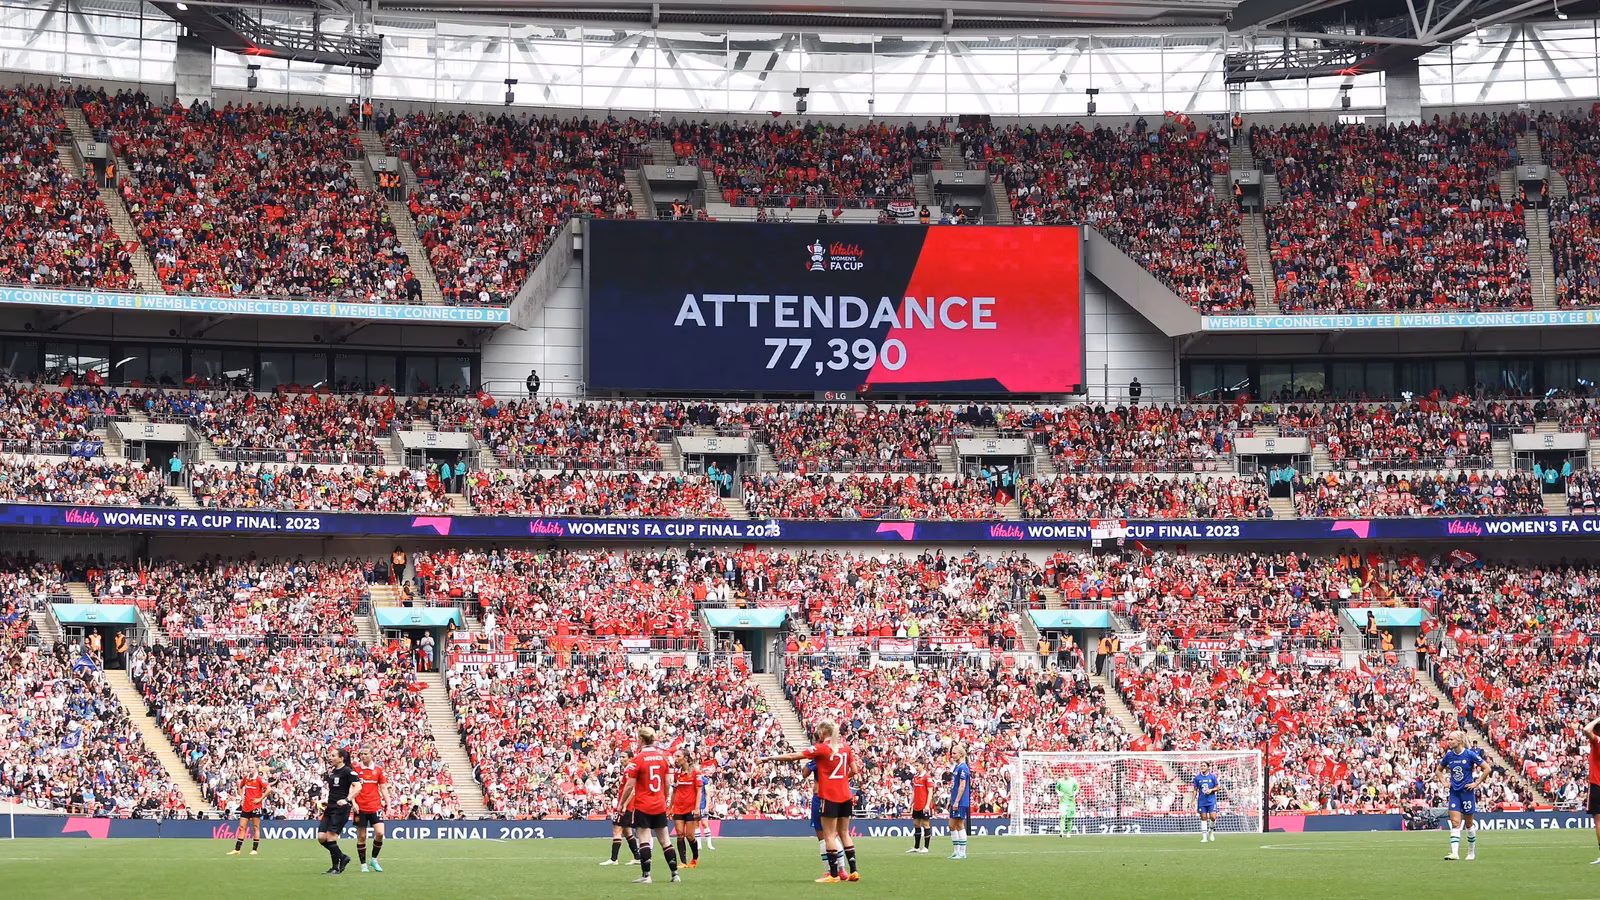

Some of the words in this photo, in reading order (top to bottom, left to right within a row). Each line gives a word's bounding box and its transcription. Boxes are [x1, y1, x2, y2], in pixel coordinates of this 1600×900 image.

[829, 241, 864, 260] Vitality
[830, 262, 842, 270] FA
[843, 262, 864, 271] CUP
[14, 291, 93, 305] CONNECTED
[97, 293, 114, 306] BY
[118, 294, 132, 306] EE
[144, 297, 207, 310] WEMBLEY
[210, 299, 288, 313] CONNECTED
[293, 302, 308, 314] BY
[312, 304, 327, 315] EE
[338, 306, 402, 318] WEMBLEY
[404, 307, 483, 320] CONNECTED
[487, 310, 504, 320] BY
[674, 293, 997, 329] ATTENDANCE
[1403, 315, 1465, 325] WEMBLEY
[1467, 314, 1545, 325] CONNECTED
[1550, 313, 1567, 323] BY
[1569, 313, 1584, 323] EE
[1209, 317, 1273, 328] WEMBLEY
[1275, 316, 1353, 327] CONNECTED
[1357, 316, 1374, 326] BY
[1377, 316, 1391, 326] EE
[764, 338, 907, 376] 77,390
[835, 392, 847, 400] LG
[64, 508, 99, 527] Vitality
[102, 512, 175, 527] WOMEN'S
[180, 515, 198, 527] FA
[202, 515, 232, 528] CUP
[285, 518, 320, 530] 2023
[529, 518, 564, 537] Vitality
[568, 522, 639, 535] WOMEN'S
[644, 523, 661, 535] FA
[665, 523, 695, 536] CUP
[699, 524, 742, 536] FINAL
[1448, 519, 1482, 536] Vitality
[1486, 521, 1557, 533] WOMEN'S
[1561, 520, 1579, 532] FA
[990, 523, 1024, 540] Vitality
[1028, 525, 1091, 537] WOMEN'
[1126, 525, 1154, 537] CUP
[1159, 525, 1201, 537] FINAL
[1205, 525, 1240, 537] 2023
[829, 752, 848, 779] 21
[649, 765, 661, 792] 5
[1463, 801, 1472, 809] 23
[1540, 818, 1560, 829] FA
[392, 827, 431, 839] CUP
[501, 827, 545, 839] 2023
